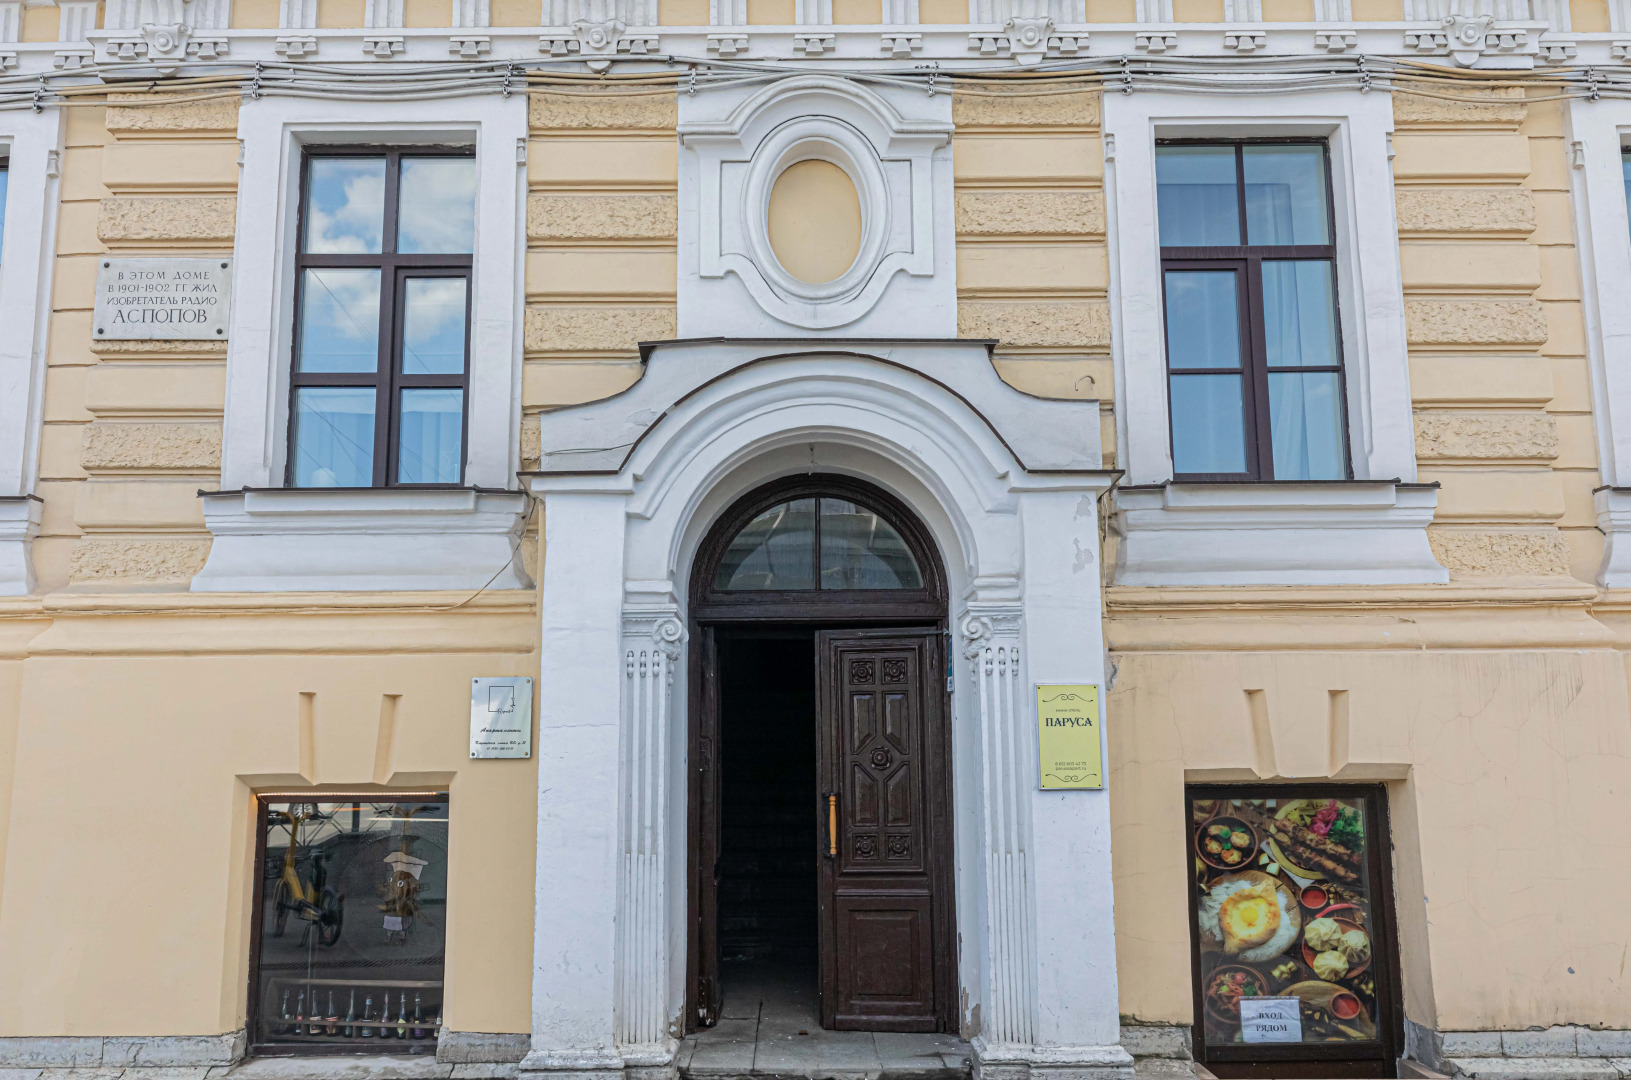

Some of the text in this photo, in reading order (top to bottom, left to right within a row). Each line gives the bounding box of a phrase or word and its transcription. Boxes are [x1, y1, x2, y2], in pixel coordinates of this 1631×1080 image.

[118, 271, 210, 280] В ЭТОМ ДОМЕ
[108, 284, 115, 293] В
[118, 283, 170, 293] 1901-1902
[191, 284, 218, 292] ЖИЛ
[106, 296, 217, 306] ИЗОБРЕТАТЕЛЬ РАДИО
[1045, 717, 1093, 728] ПАРУСА
[1258, 1012, 1283, 1020] ВХОД
[1256, 1024, 1288, 1033] РЯДОМ
